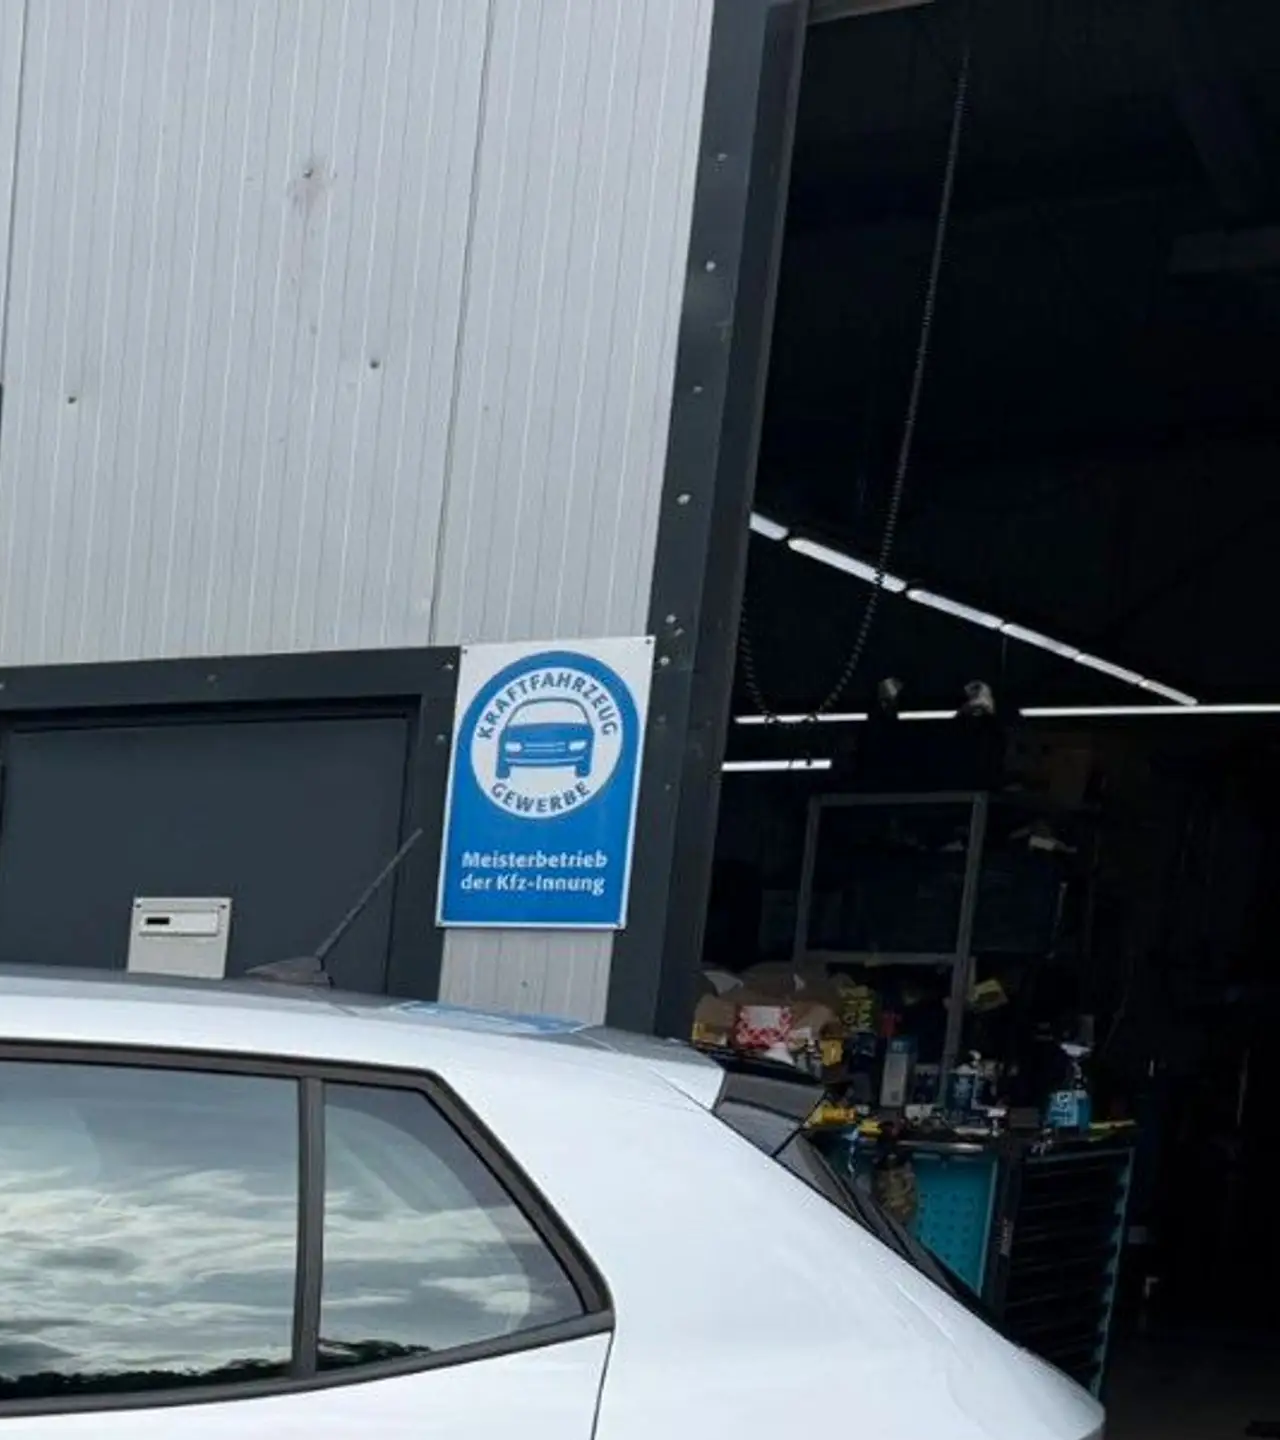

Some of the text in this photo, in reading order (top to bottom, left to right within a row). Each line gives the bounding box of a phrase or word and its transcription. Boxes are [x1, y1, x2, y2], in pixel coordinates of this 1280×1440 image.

[476, 671, 618, 739] KRAFTFAHRZEUG
[491, 781, 591, 814] GEWERBE
[461, 850, 608, 869] Meisterbetrieb
[461, 872, 606, 896] der Kfz-Innung
